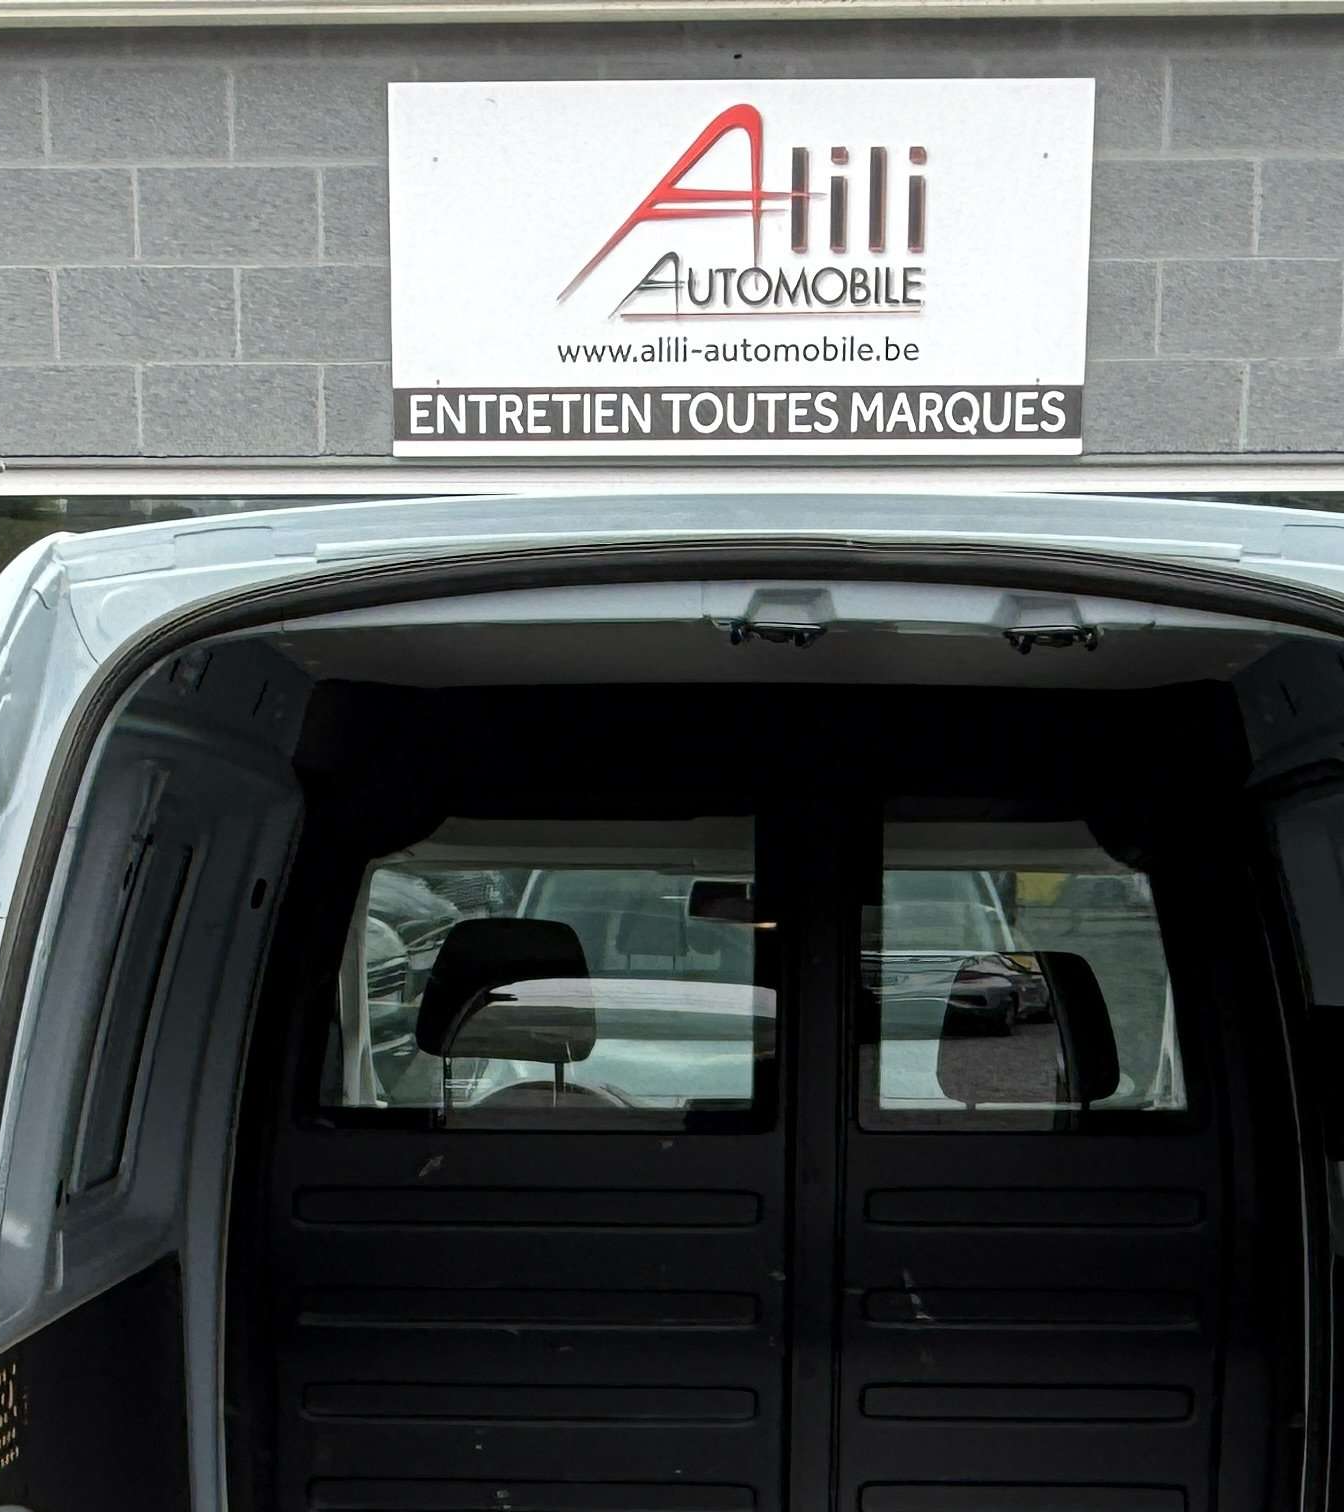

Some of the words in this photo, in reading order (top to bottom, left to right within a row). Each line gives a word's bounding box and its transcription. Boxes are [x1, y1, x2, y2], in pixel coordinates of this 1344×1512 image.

[557, 103, 927, 303] Alili
[609, 251, 923, 318] AUTOMOBILE
[557, 336, 920, 364] www.alili-automobile.be
[409, 393, 653, 435] ENTRETIEN
[660, 391, 840, 435] TOUTES
[849, 390, 1067, 436] MARQUES
